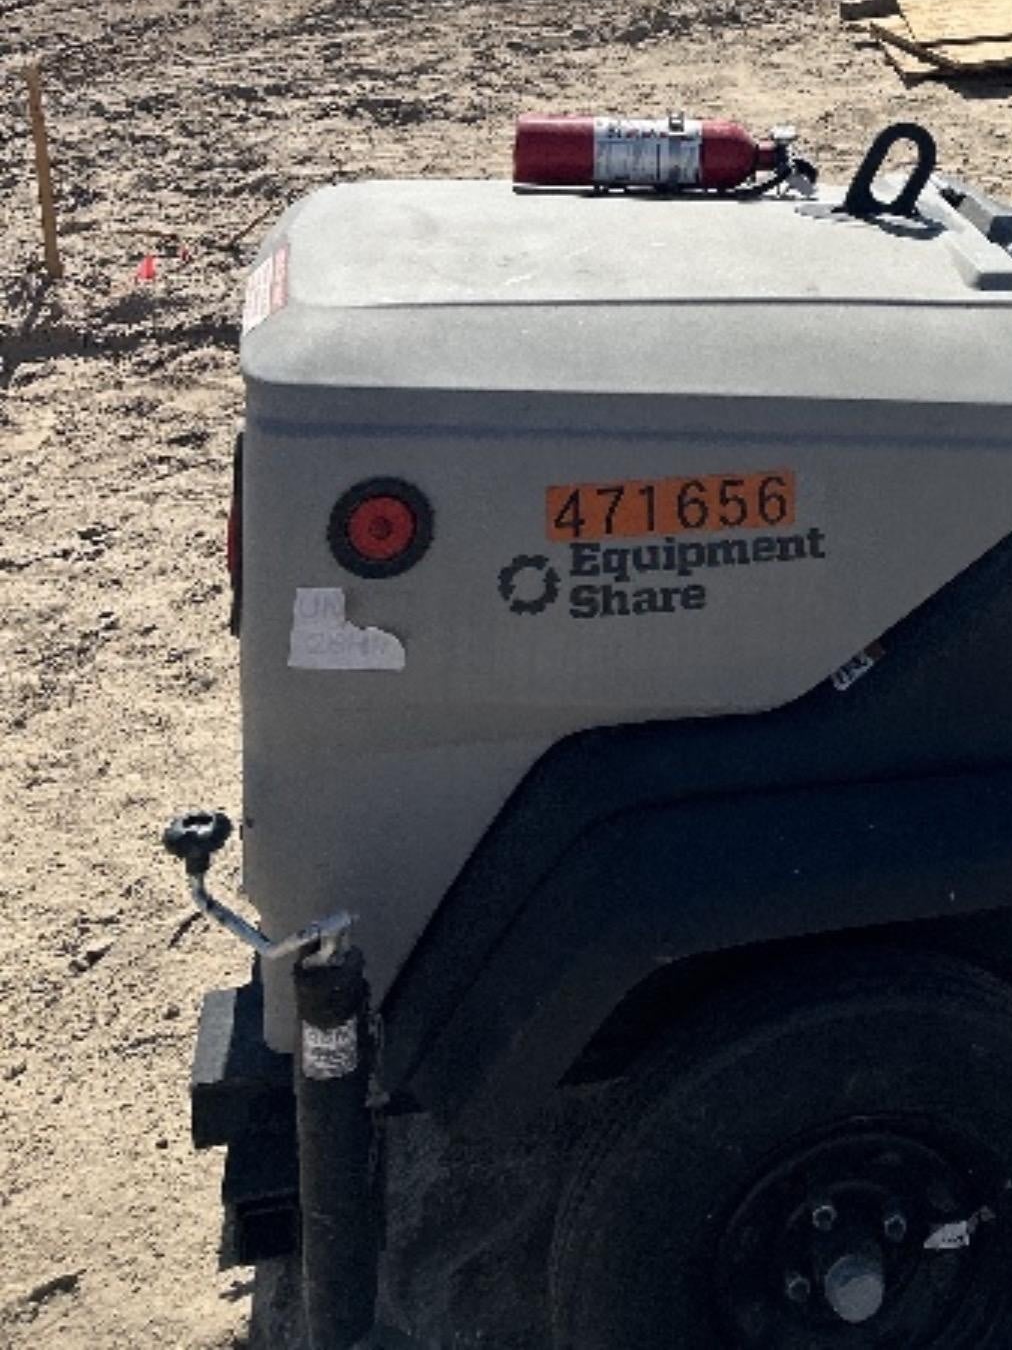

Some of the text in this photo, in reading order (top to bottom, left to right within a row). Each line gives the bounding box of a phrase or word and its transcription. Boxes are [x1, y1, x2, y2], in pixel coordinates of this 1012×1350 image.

[553, 476, 789, 535] 471656
[569, 528, 828, 578] Equipment
[569, 580, 708, 619] Share
